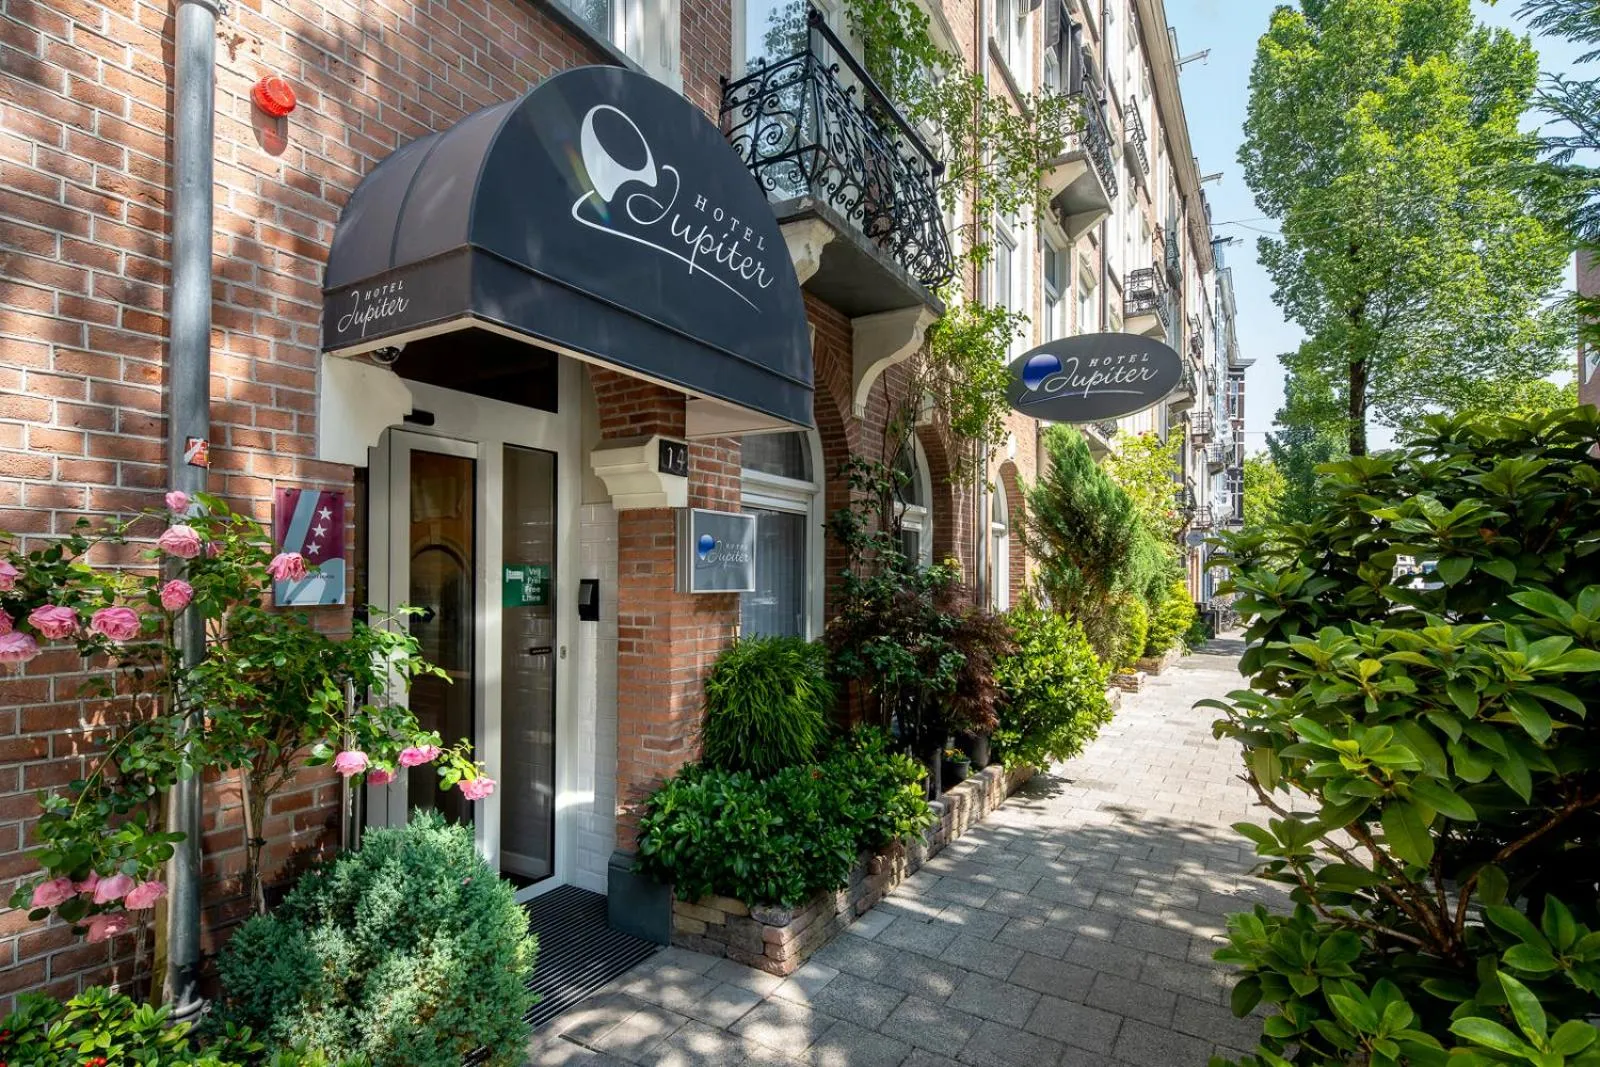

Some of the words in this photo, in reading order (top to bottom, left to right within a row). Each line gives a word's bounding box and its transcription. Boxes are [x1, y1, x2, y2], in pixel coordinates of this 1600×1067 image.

[626, 164, 774, 288] Jupiter
[694, 194, 765, 251] HOTEL
[364, 280, 404, 300] HOTEL
[337, 290, 409, 337] Jupiter
[1044, 356, 1159, 398] Jupiter
[1088, 352, 1150, 368] HOTEL
[667, 447, 687, 472] 14
